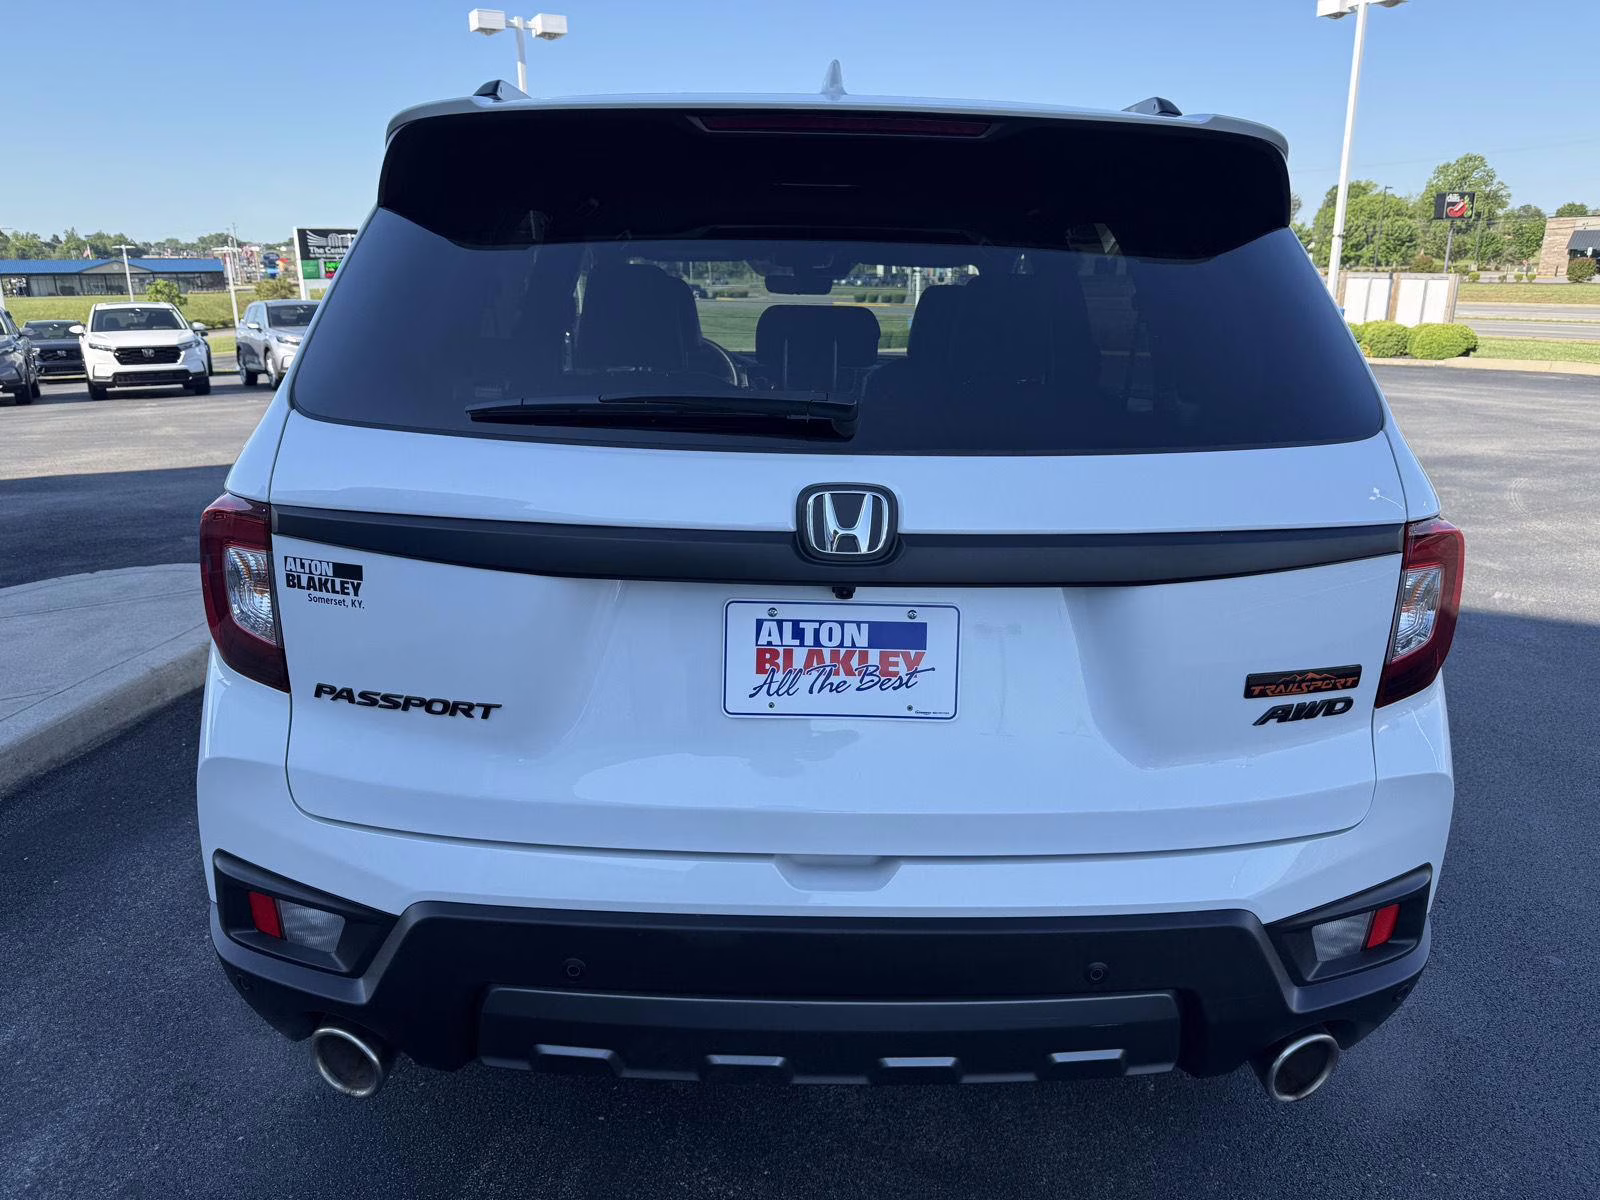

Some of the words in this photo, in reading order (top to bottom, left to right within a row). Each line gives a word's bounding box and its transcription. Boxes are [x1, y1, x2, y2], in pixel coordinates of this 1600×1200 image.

[308, 246, 324, 254] The
[325, 246, 347, 254] Cente
[285, 557, 333, 577] ALTON
[285, 572, 362, 597] BLAKLEY
[307, 593, 349, 609] Somerset,
[351, 598, 365, 609] KY.
[757, 620, 869, 648] ALTON
[755, 647, 926, 678] BLAKLEY
[748, 667, 804, 698] All
[806, 663, 851, 695] The
[855, 664, 936, 692] Best
[1250, 676, 1358, 696] TRAILSPORT
[313, 683, 502, 720] PASSPORT
[1252, 696, 1354, 726] AWD
